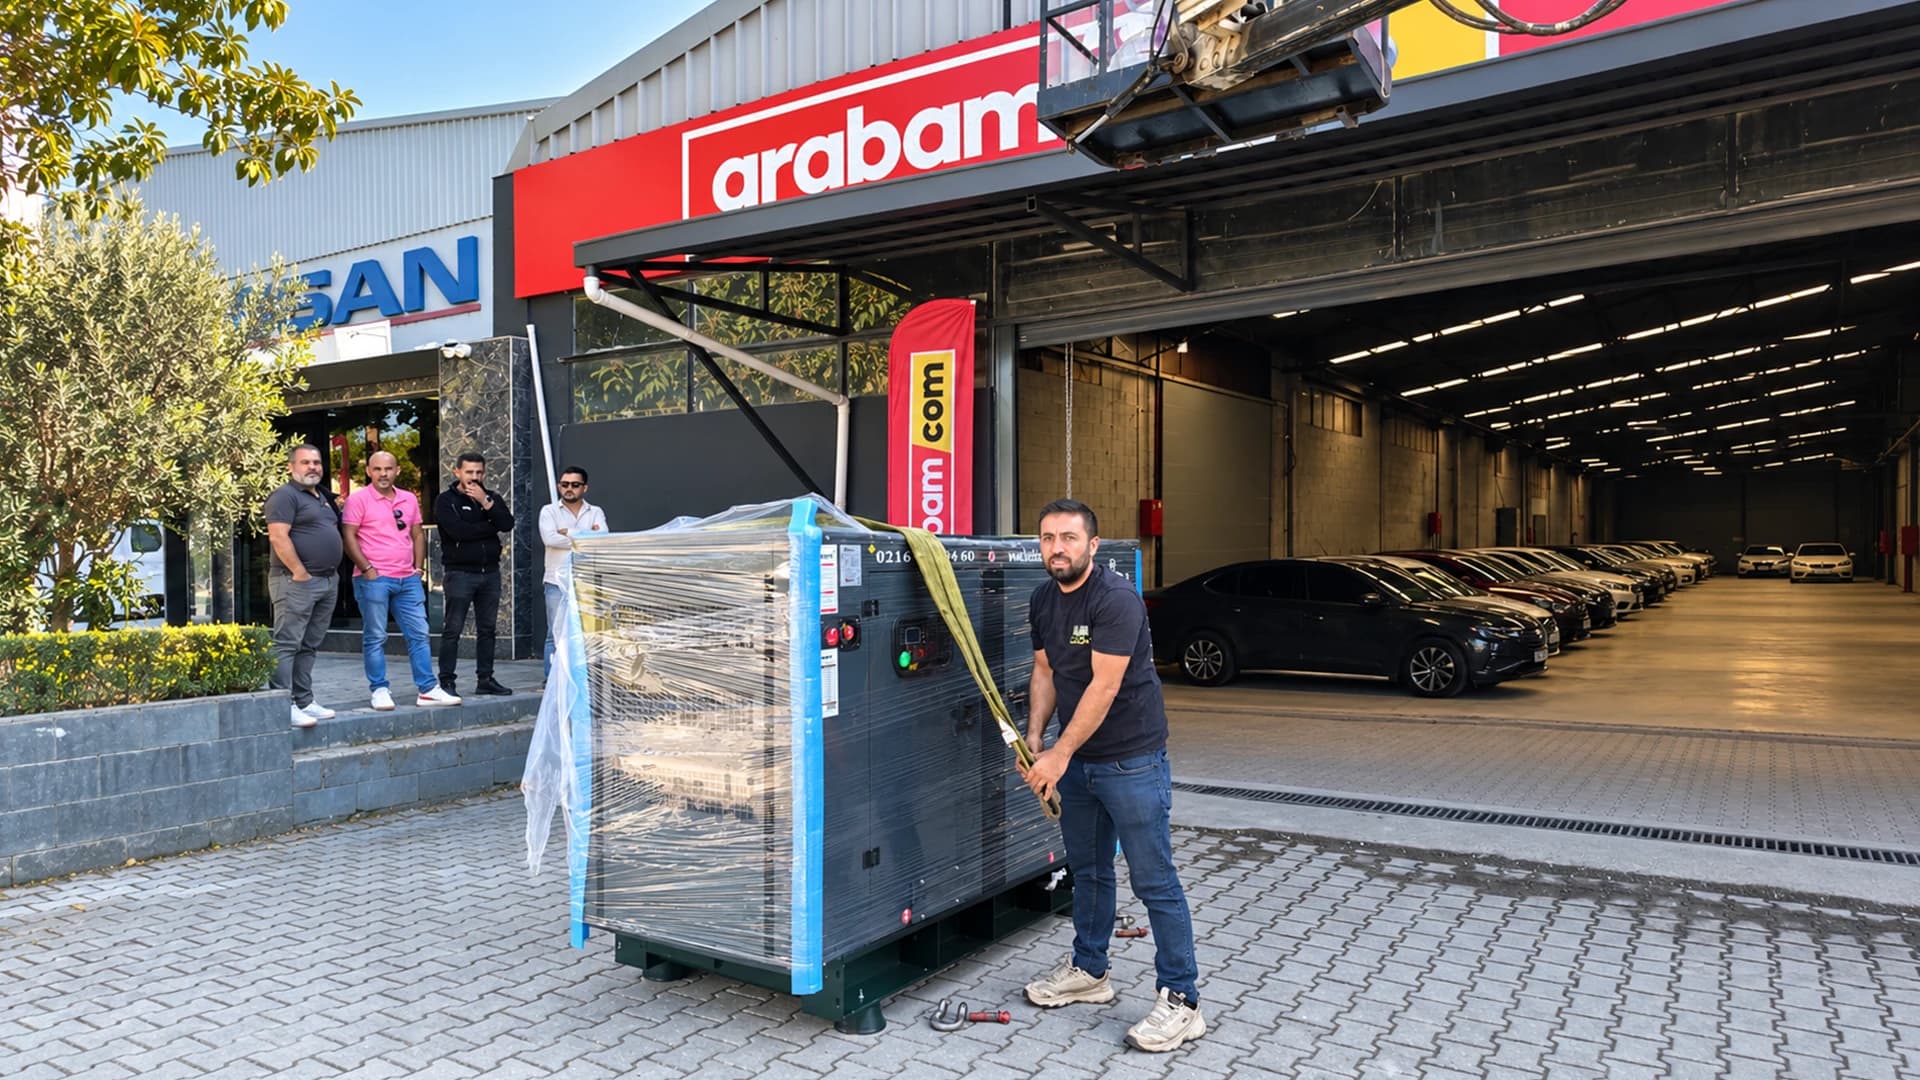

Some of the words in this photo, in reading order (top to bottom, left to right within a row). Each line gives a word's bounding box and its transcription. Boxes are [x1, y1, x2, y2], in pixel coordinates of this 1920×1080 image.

[713, 82, 1058, 213] arabam
[923, 363, 944, 443] com
[876, 550, 911, 563] 0216
[961, 550, 975, 562] 60
